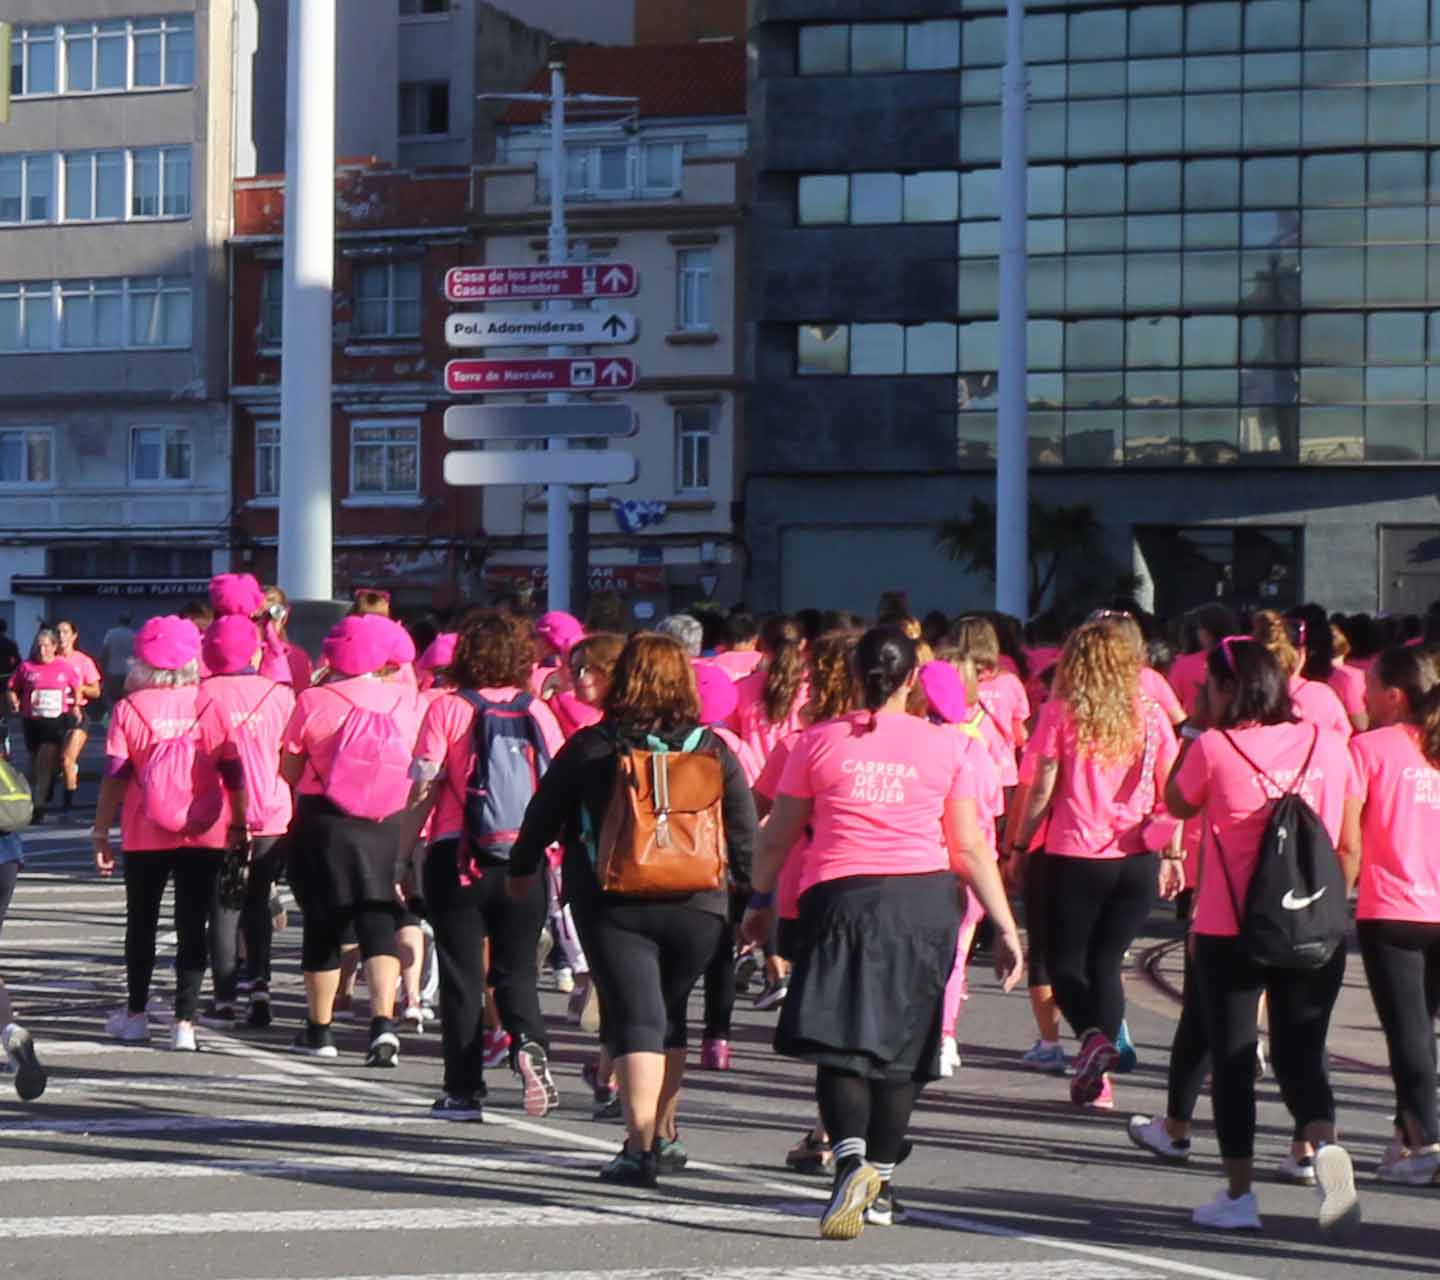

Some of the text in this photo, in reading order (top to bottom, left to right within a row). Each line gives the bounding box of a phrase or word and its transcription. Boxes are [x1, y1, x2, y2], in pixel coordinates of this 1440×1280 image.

[453, 271, 485, 284] Casa
[488, 270, 505, 282] de
[507, 269, 527, 281] los
[453, 283, 485, 296] Casa
[488, 283, 509, 295] del
[454, 321, 585, 334] Pol. Adormideras
[453, 371, 481, 383] Torre
[485, 370, 500, 382] de
[841, 759, 919, 779] CARRERA
[855, 773, 905, 790] DE LA
[849, 787, 906, 804] MUJER
